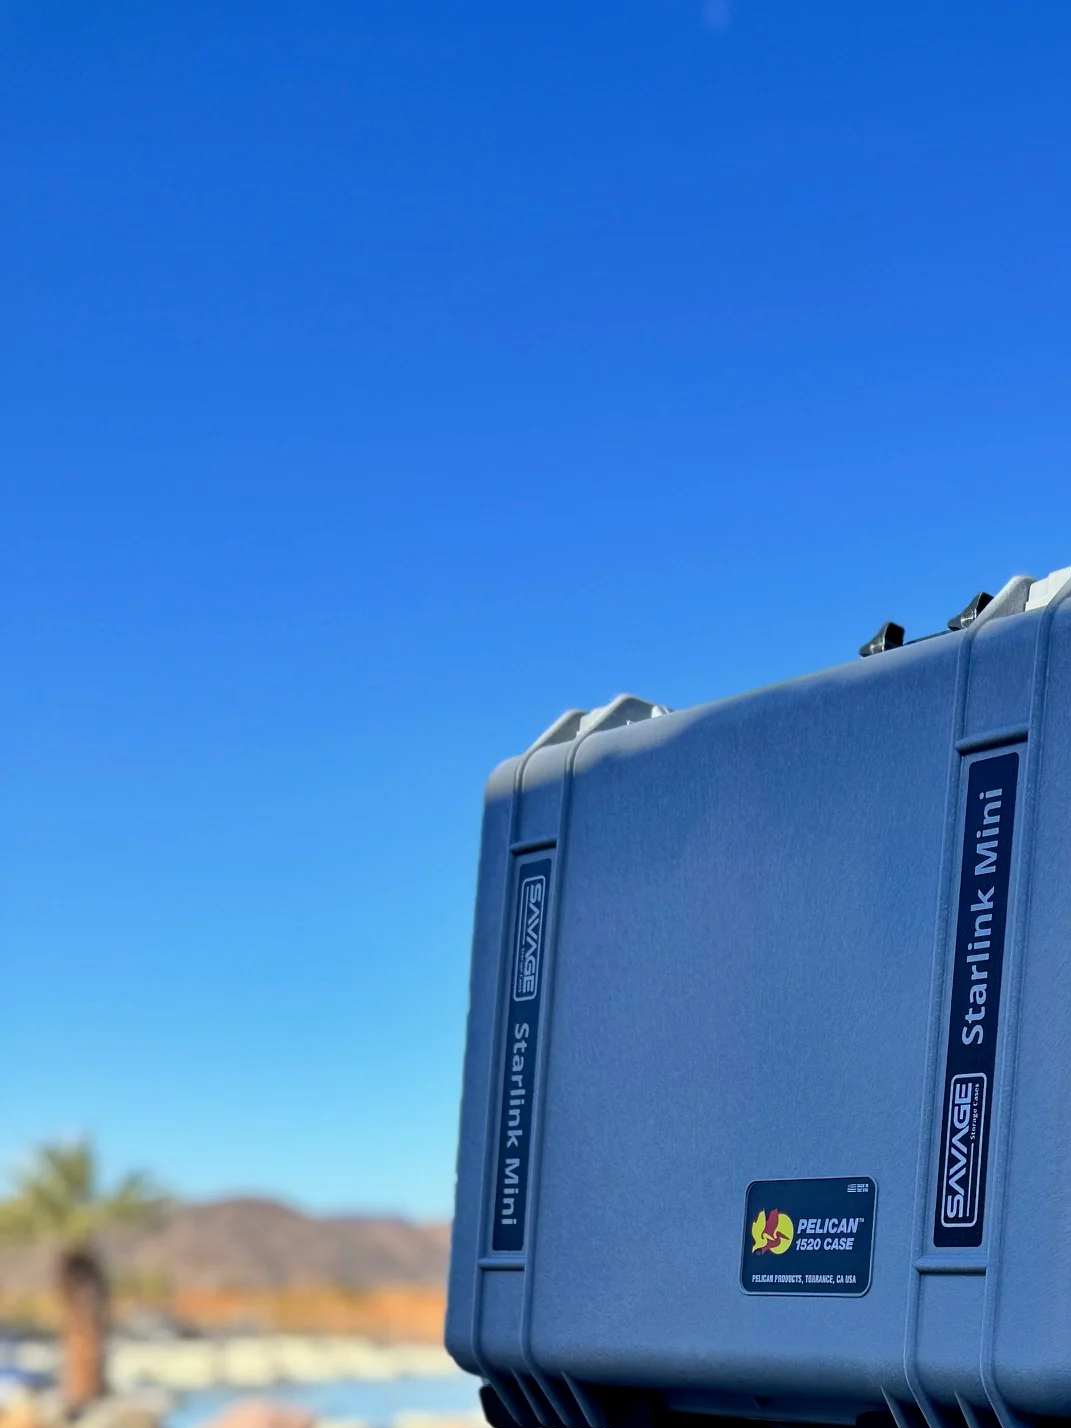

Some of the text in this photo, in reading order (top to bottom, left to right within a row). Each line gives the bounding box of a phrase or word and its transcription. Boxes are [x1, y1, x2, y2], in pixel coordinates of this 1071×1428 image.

[523, 883, 541, 993] SAVAGE
[962, 787, 1002, 1045] Starlink Mini
[501, 1022, 530, 1226] Starlink Mini
[947, 1082, 972, 1218] SAVAGE
[752, 1274, 774, 1283] PELICAN
[836, 1274, 844, 1284] CA
[845, 1275, 857, 1284] USA
[795, 1237, 855, 1251] 1520 CASE
